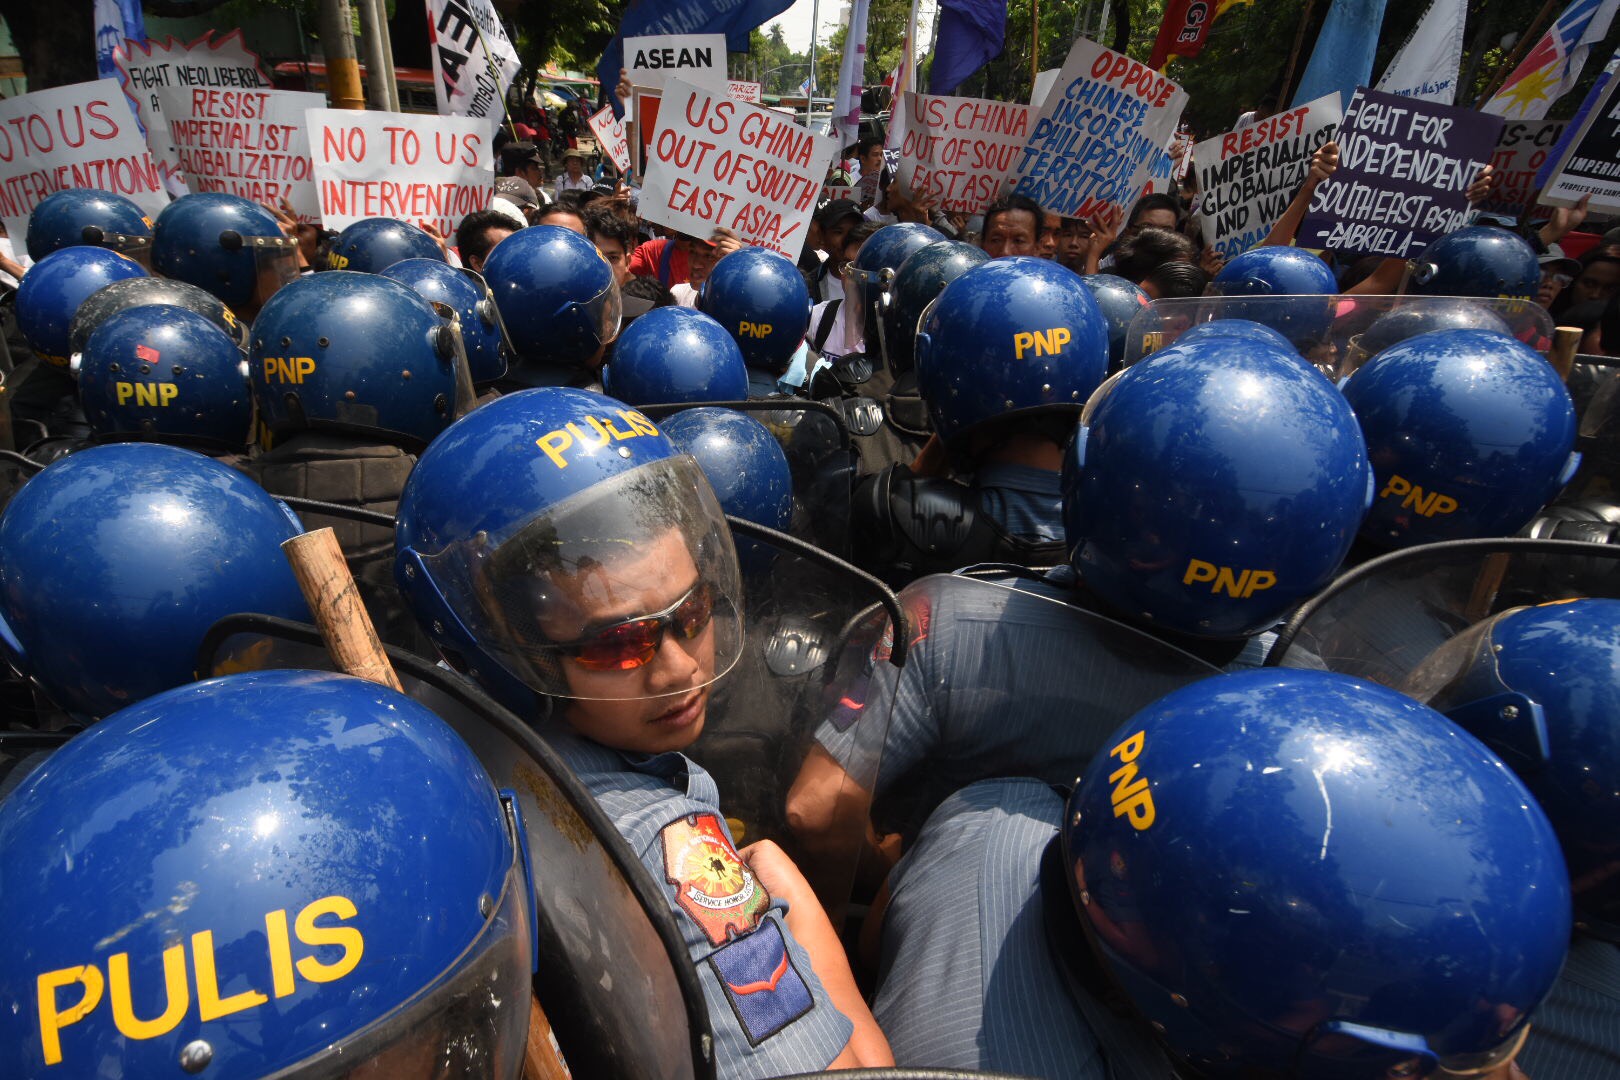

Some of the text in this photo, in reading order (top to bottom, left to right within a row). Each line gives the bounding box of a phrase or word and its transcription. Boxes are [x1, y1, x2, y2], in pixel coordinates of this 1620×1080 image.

[129, 64, 270, 89] FIGHT NEOLIBERAL
[633, 48, 712, 69] ASEAN
[1090, 50, 1175, 108] OPPOSE
[192, 88, 270, 120] RESIST
[686, 91, 735, 135] US
[954, 102, 1028, 137] CHINA
[1065, 76, 1149, 128] CHINESE
[1341, 92, 1454, 149] FIGHT FOR
[8, 113, 54, 157] TO
[57, 100, 119, 149] US
[171, 119, 298, 151] IMPERIALIST
[323, 126, 481, 168] NO TO US
[1220, 106, 1310, 160] RESIST
[657, 128, 716, 175] OUT
[713, 149, 754, 186] OF
[746, 159, 819, 213] SOUTH
[902, 129, 1021, 172] OUT OF SOUT
[1202, 122, 1337, 192] IMPERIALIST
[1335, 130, 1487, 192] INDEPENDENT
[1567, 156, 1620, 179] IMPERIA
[322, 180, 494, 216] INTERVENTION!
[910, 164, 966, 198] EAST
[961, 174, 1000, 202] ASI
[1308, 178, 1433, 229] SOUTHEAST
[667, 177, 802, 244] EAST ASIA!
[1215, 205, 1249, 239] AND
[739, 321, 773, 339] PNP
[1014, 327, 1071, 359] PNP
[264, 357, 316, 384] PNP
[115, 381, 179, 407] PNP
[536, 408, 660, 470] PULIS
[1380, 474, 1458, 518] PNP
[1182, 558, 1277, 599] PNP
[1109, 729, 1156, 831] PNP
[693, 891, 722, 907] SERVICE
[36, 895, 364, 1065] PULIS
